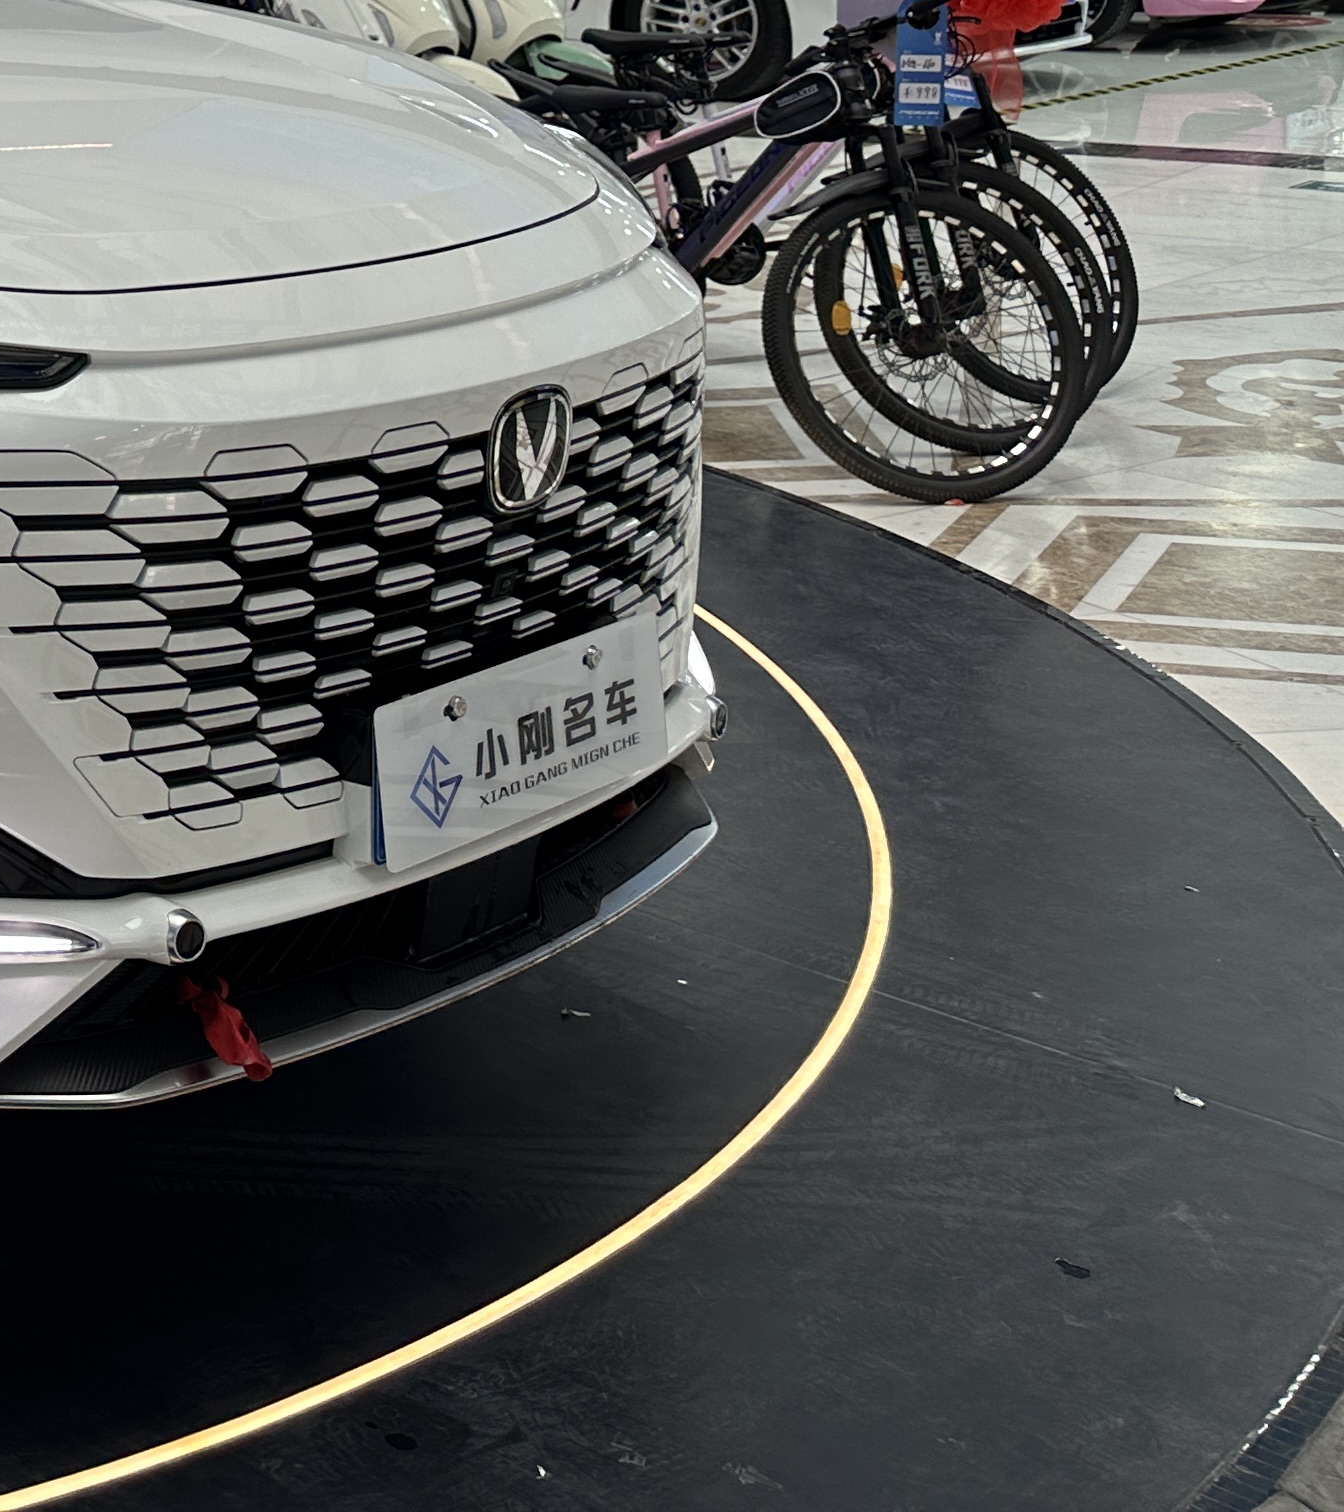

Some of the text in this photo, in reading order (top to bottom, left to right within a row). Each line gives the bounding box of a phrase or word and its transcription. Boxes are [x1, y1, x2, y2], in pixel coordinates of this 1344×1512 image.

[955, 230, 978, 269] ORK
[475, 678, 639, 780] 小刚名车
[479, 731, 641, 809] XIAO GANG MIGN CHE
